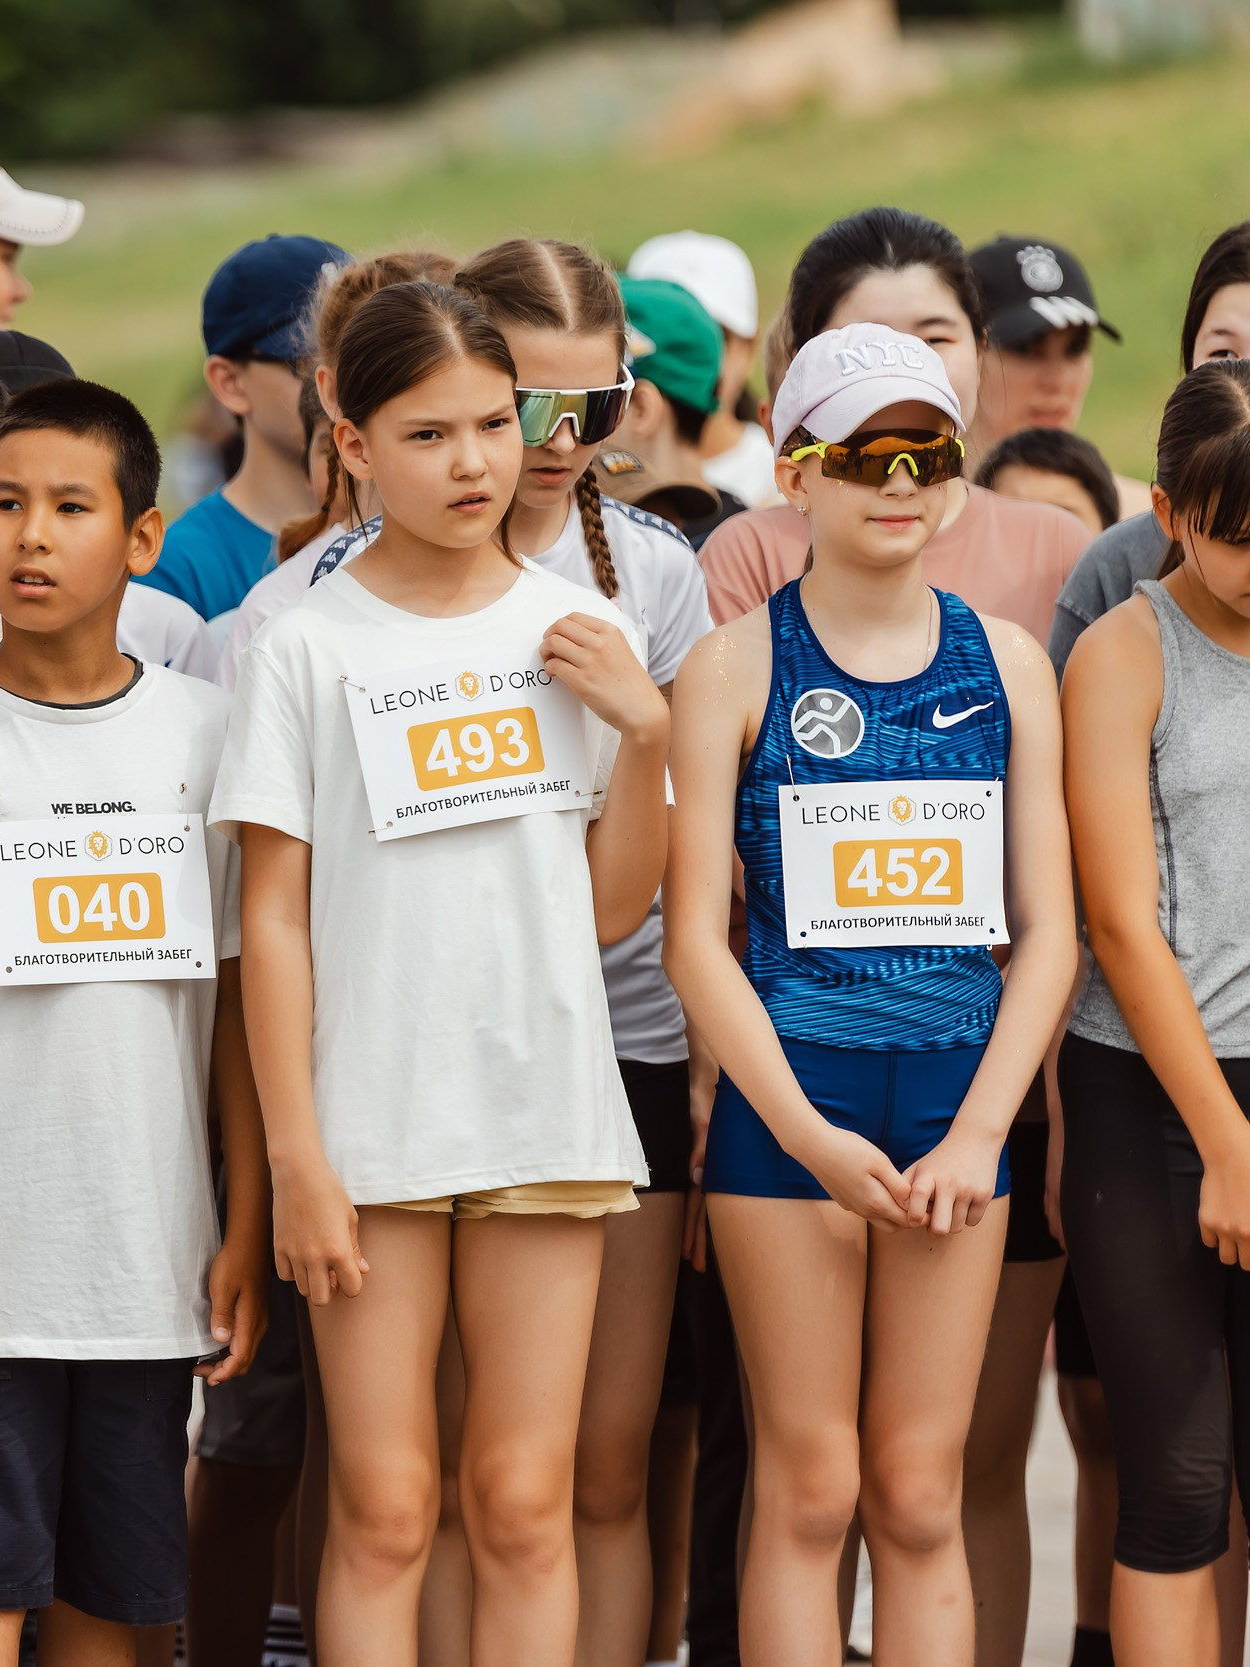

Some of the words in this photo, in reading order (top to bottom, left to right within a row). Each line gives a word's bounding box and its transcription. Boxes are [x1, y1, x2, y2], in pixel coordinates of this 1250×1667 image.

[836, 341, 924, 376] NYC
[370, 684, 449, 714] LEONE
[490, 669, 552, 692] D'ORO
[426, 717, 530, 777] 493
[51, 803, 74, 815] WE
[75, 800, 137, 815] BELONG.
[396, 781, 537, 819] БЛАГОТВОРИТЕЛЬНЫЙ
[540, 779, 571, 794] ЗАБЕГ
[802, 804, 881, 825] LEONE
[923, 802, 985, 820] D'ORO
[0, 840, 78, 861] LEONE
[119, 836, 185, 855] D'ORO
[847, 847, 951, 897] 452
[48, 881, 151, 934] 040
[811, 914, 951, 930] БЛАГОТВОРИТЕЛЬНЫЙ
[954, 917, 986, 927] ЗАБЕГ
[14, 948, 154, 966] БЛАГОТВОРИТЕЛЬНЫЙ
[157, 949, 193, 960] ЗАБЕГ
